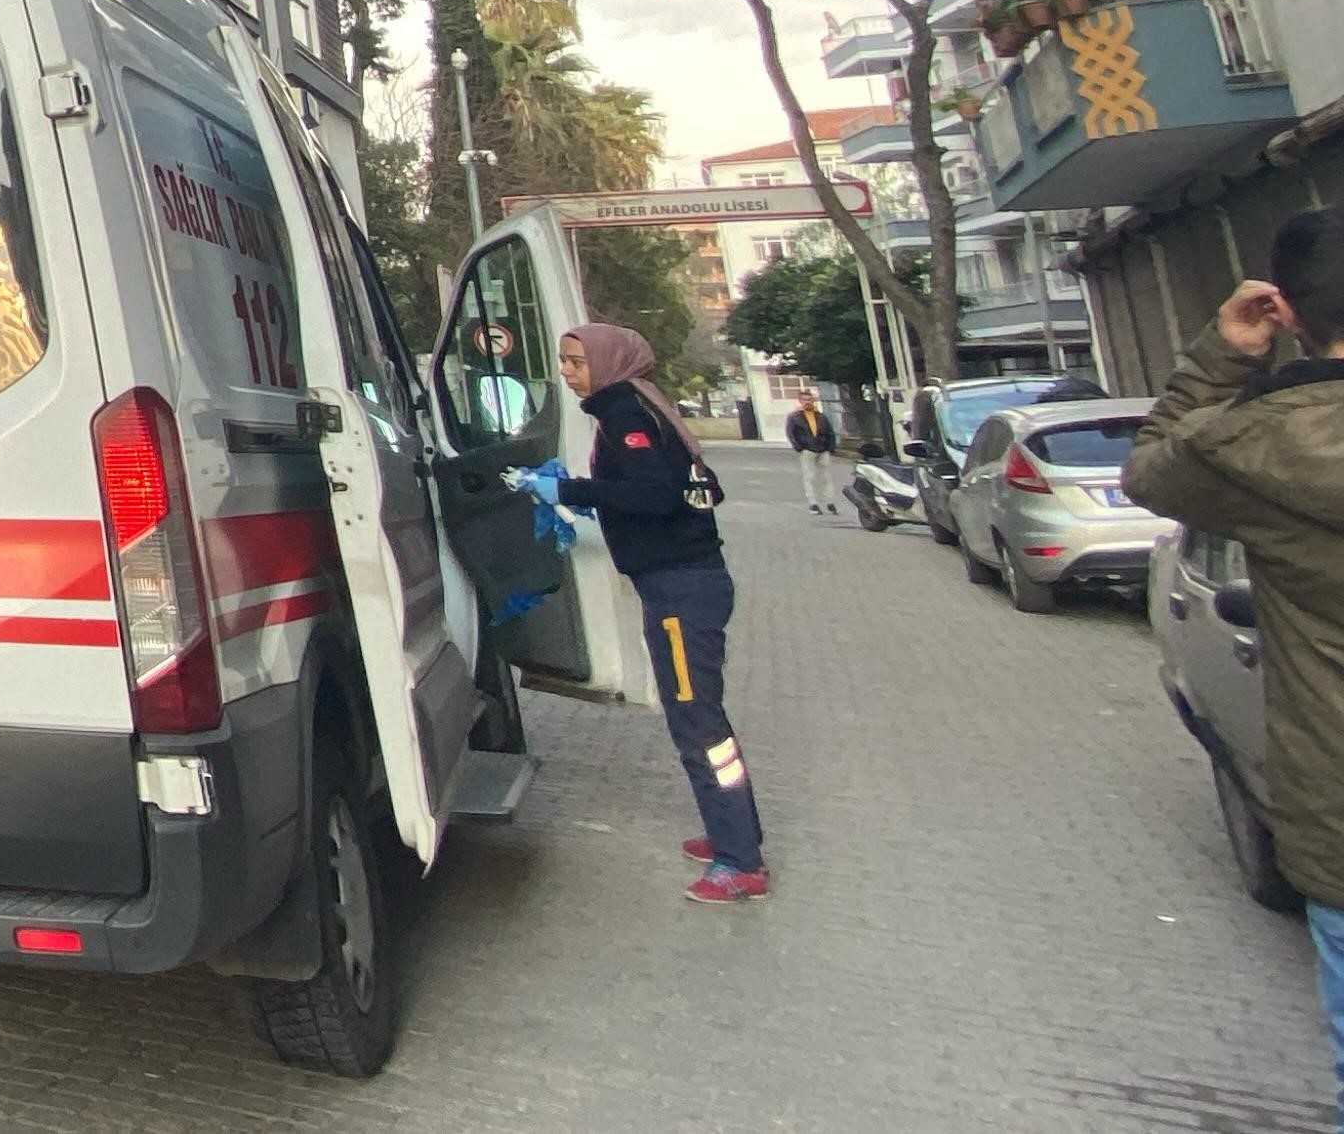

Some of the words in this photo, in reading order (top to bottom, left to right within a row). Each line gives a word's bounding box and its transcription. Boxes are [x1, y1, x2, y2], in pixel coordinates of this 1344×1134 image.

[154, 161, 230, 249] SAĞLIK
[597, 205, 646, 218] EFELER
[650, 202, 720, 216] ANADOLU
[724, 197, 769, 212] LİSESİ
[233, 274, 298, 389] 112
